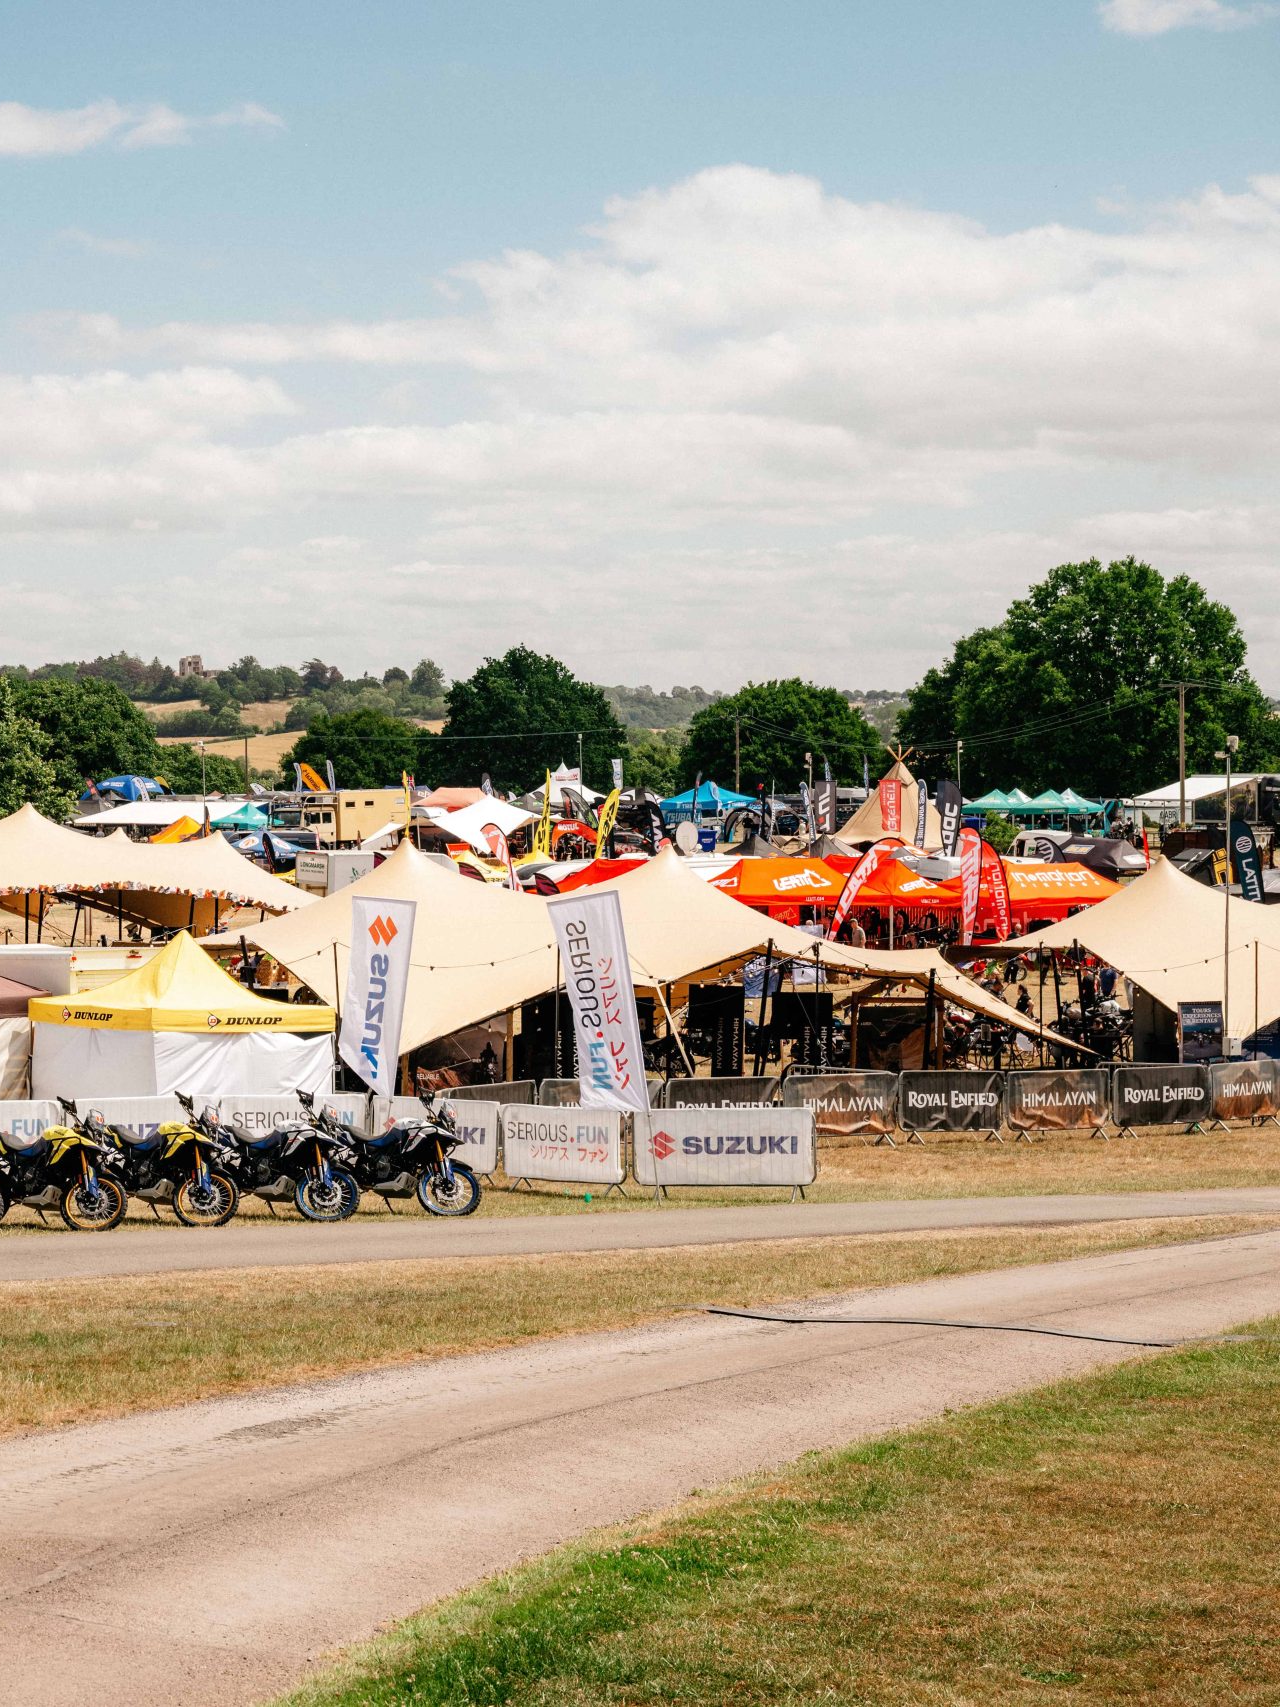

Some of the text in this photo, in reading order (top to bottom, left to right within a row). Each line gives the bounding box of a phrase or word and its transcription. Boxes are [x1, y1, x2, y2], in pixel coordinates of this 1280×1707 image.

[74, 1011, 113, 1021] DUNLOP
[226, 1017, 283, 1025] DUNLOP
[1222, 1080, 1273, 1098] HIMALAYAN
[803, 1097, 884, 1112] HIMALAYAN
[1022, 1091, 1096, 1107] HIMALAYAN
[507, 1121, 609, 1144] SERIOUS.FUN
[530, 1144, 609, 1163] シリアス ファン
[682, 1136, 798, 1155] SUZUKI
